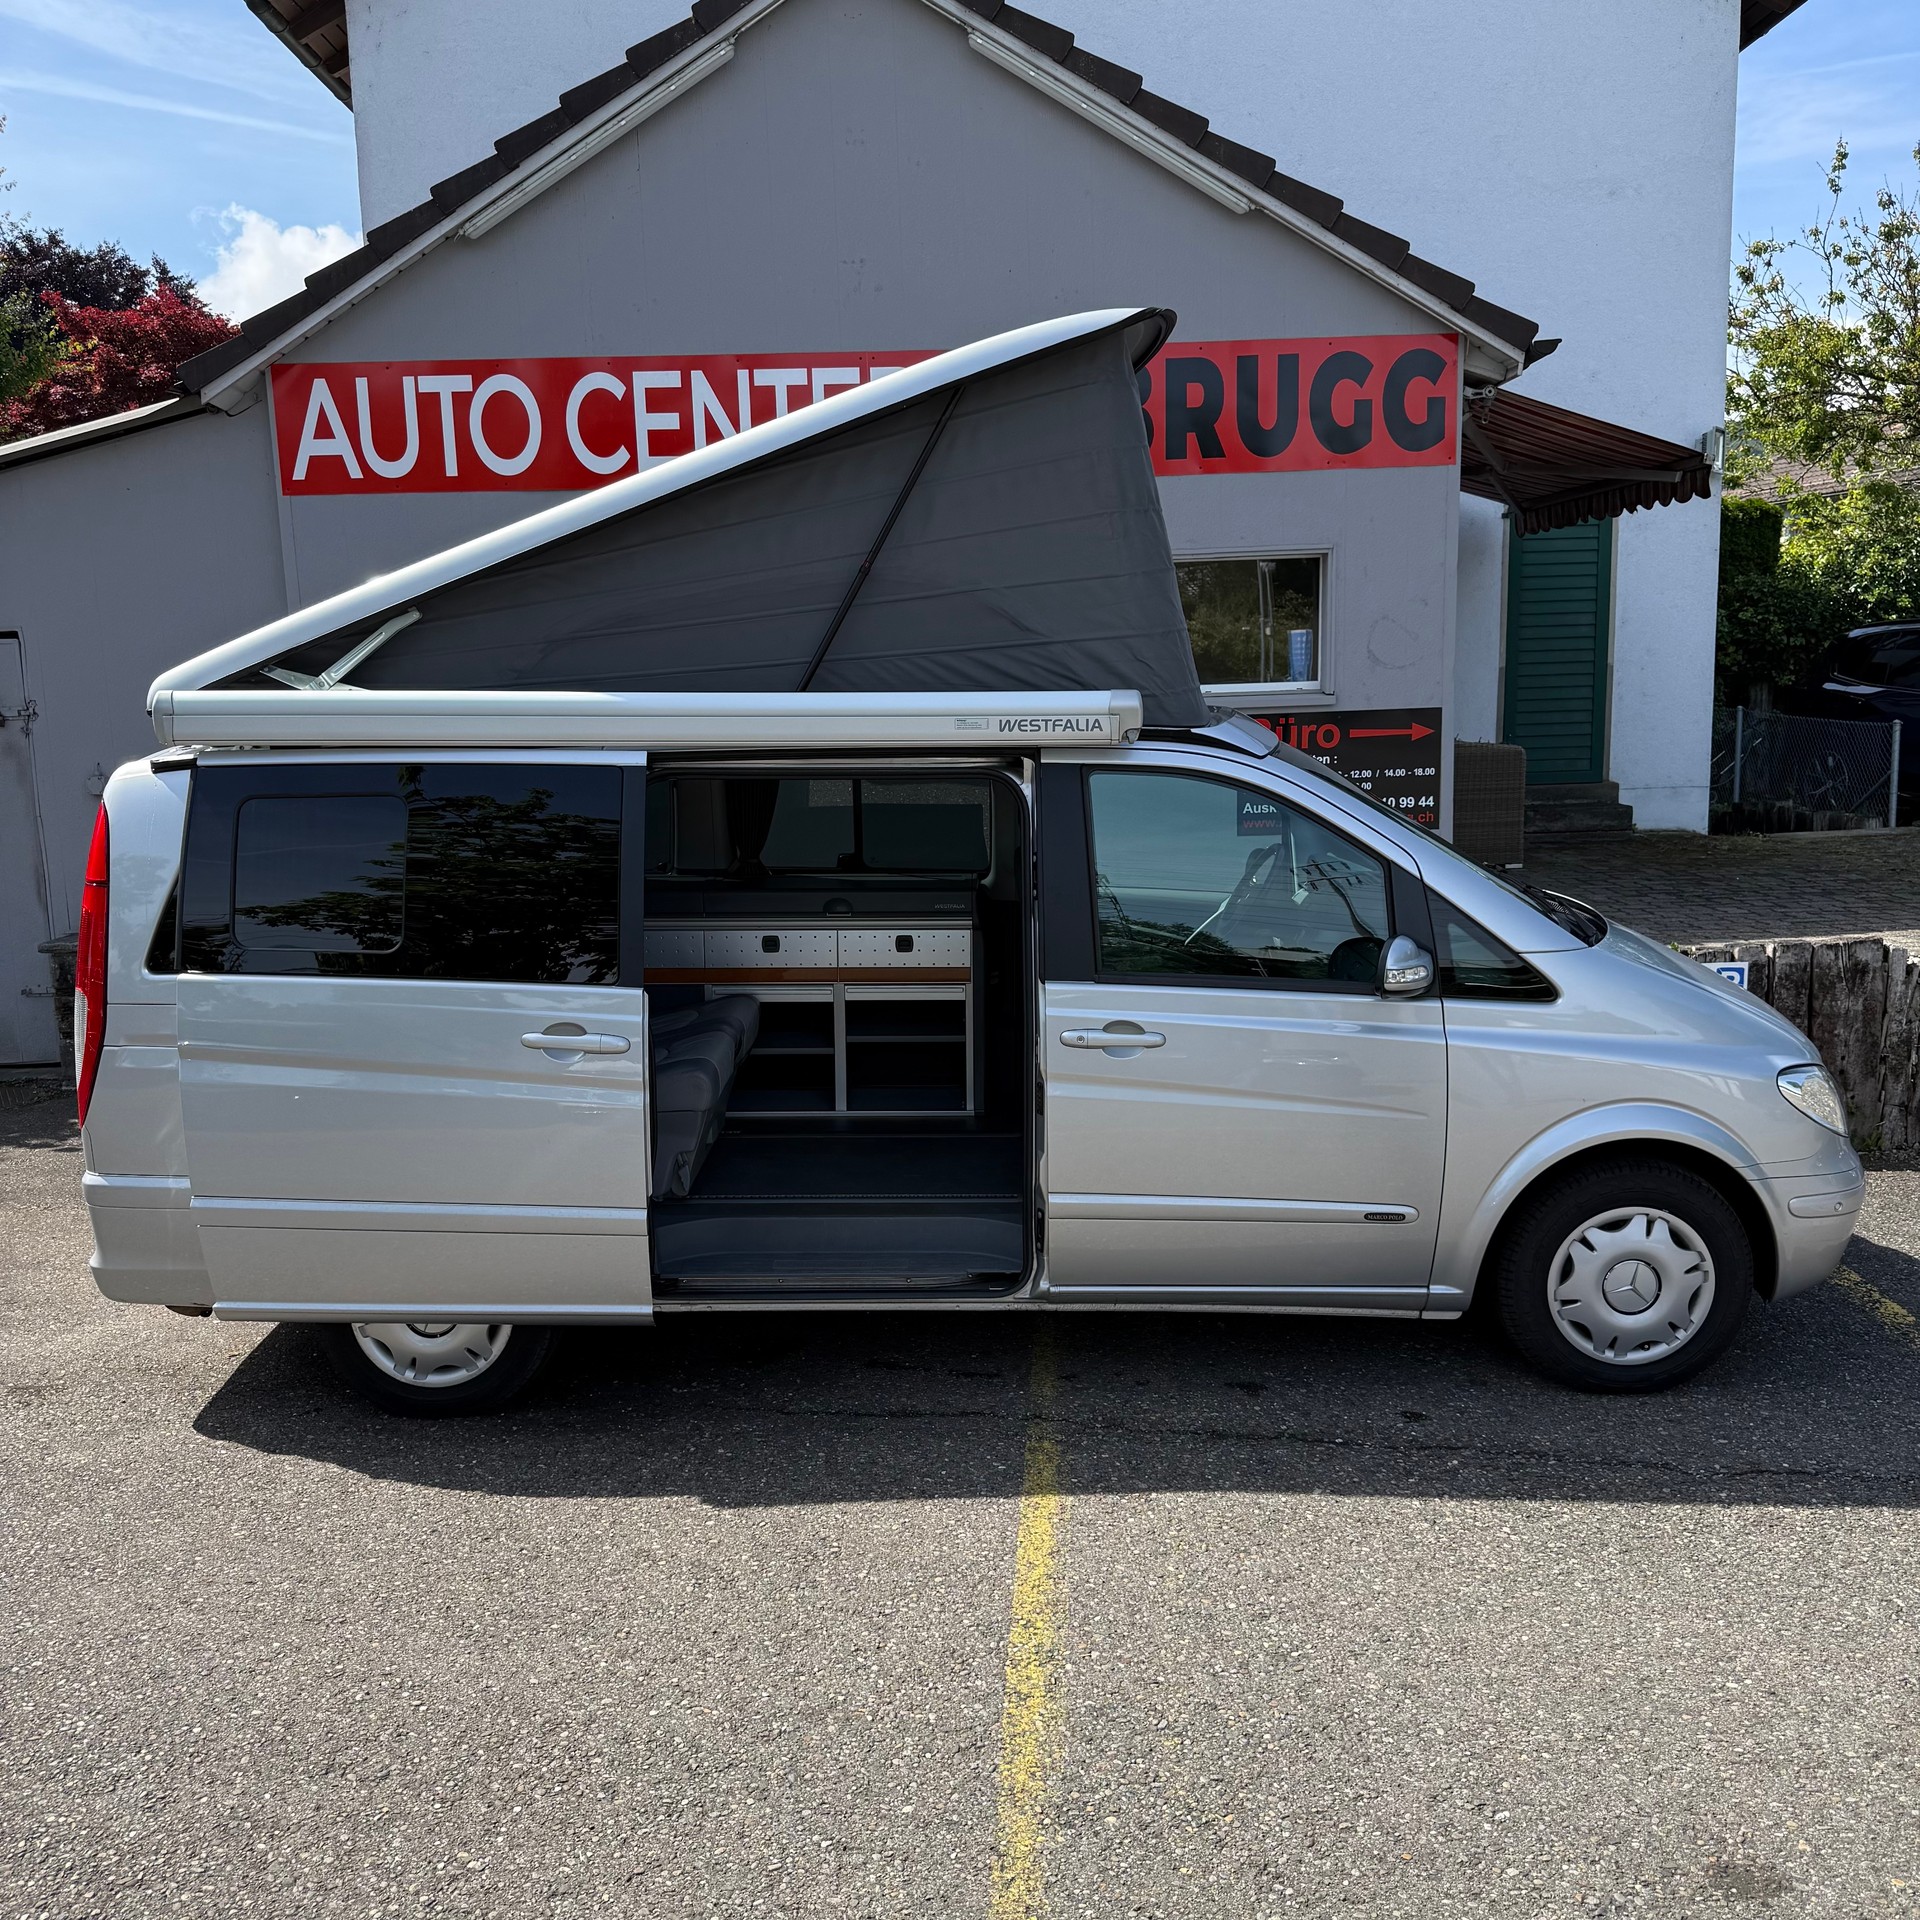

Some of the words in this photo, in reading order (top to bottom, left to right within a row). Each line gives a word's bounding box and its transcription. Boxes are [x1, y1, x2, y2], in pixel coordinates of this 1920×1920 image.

[292, 373, 542, 480] AUTO
[998, 718, 1104, 733] WESTFALIA
[1254, 717, 1341, 749] üro
[1350, 769, 1372, 778] 12.00
[1384, 768, 1406, 777] 14.00
[1414, 767, 1436, 776] 18.00
[1399, 796, 1415, 808] 99
[1418, 795, 1435, 808] 44
